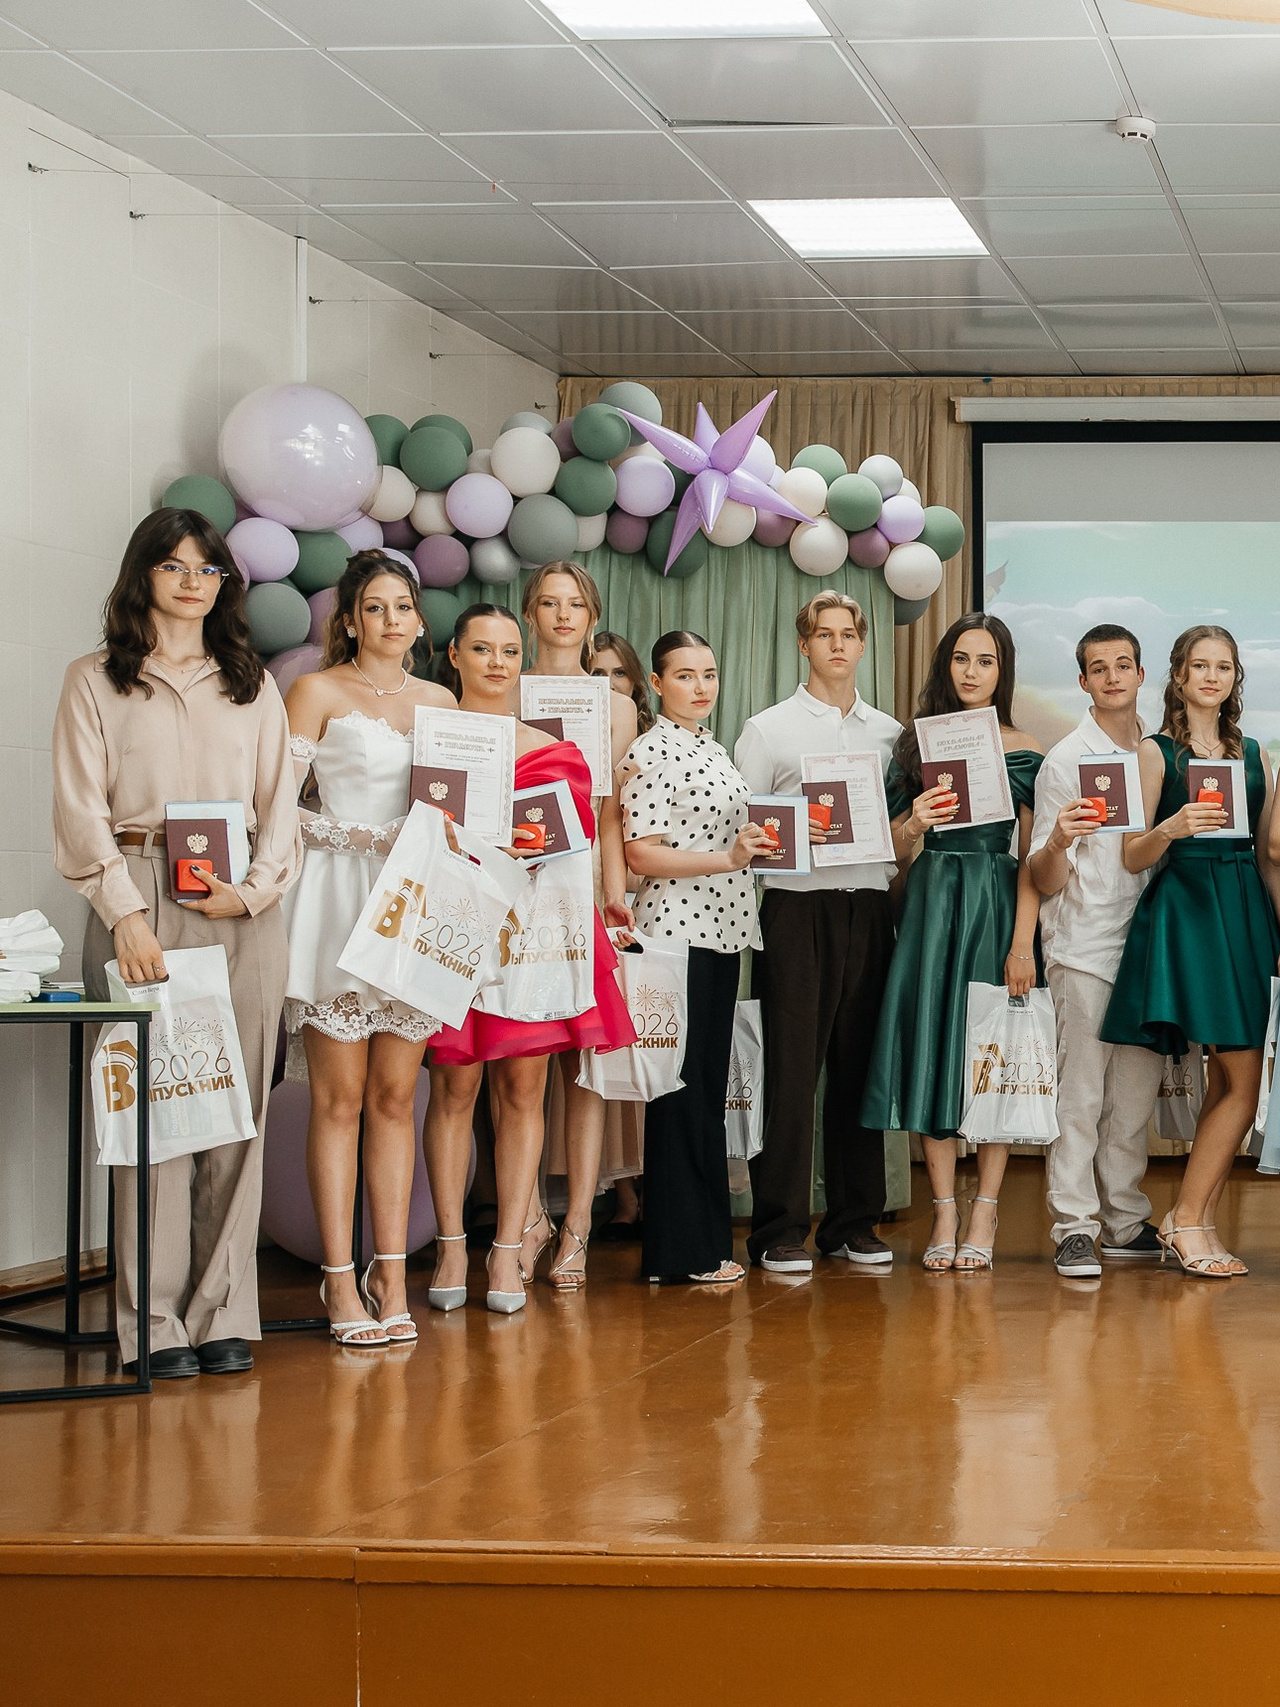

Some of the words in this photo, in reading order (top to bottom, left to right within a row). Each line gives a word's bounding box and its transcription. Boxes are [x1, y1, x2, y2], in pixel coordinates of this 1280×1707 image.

[420, 916, 484, 966] 2026
[633, 1013, 678, 1036] 026
[150, 1046, 231, 1086] 2026
